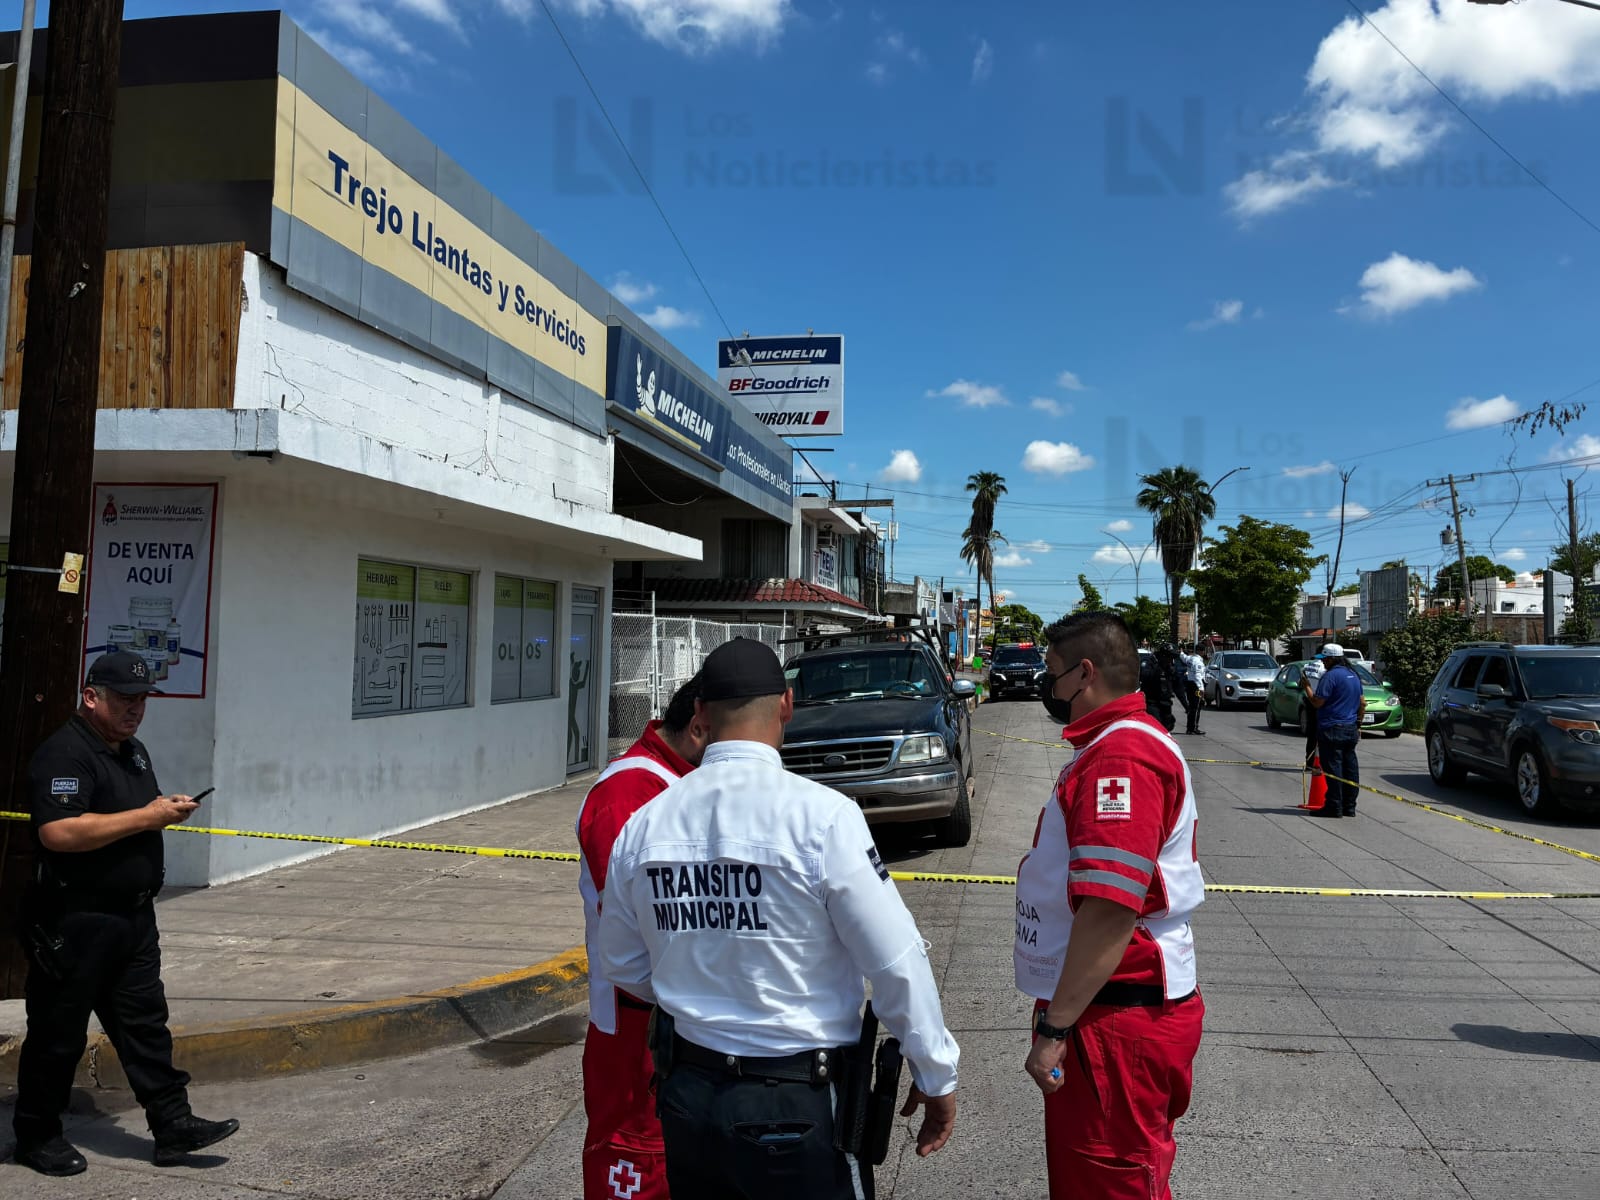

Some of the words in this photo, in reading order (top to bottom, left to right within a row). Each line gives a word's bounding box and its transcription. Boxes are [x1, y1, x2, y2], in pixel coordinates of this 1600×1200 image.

[328, 150, 403, 235] Trejo
[412, 210, 492, 296] Llantas
[498, 279, 509, 312] y
[514, 284, 586, 356] Servicios
[752, 348, 827, 360] MICHELIN
[728, 376, 830, 391] BFGoodrich
[657, 389, 714, 443] MICHELIN
[752, 411, 810, 426] NIROYAL
[737, 445, 771, 482] Profesionales
[108, 541, 132, 559] DE
[135, 542, 194, 561] VENTA
[126, 564, 174, 585] AQUÍ
[366, 571, 398, 587] HERRAJES
[498, 642, 542, 660] OLOS
[647, 864, 762, 899] TRANSITO
[652, 901, 768, 931] MUNICIPAL
[1015, 921, 1038, 947] ANA
